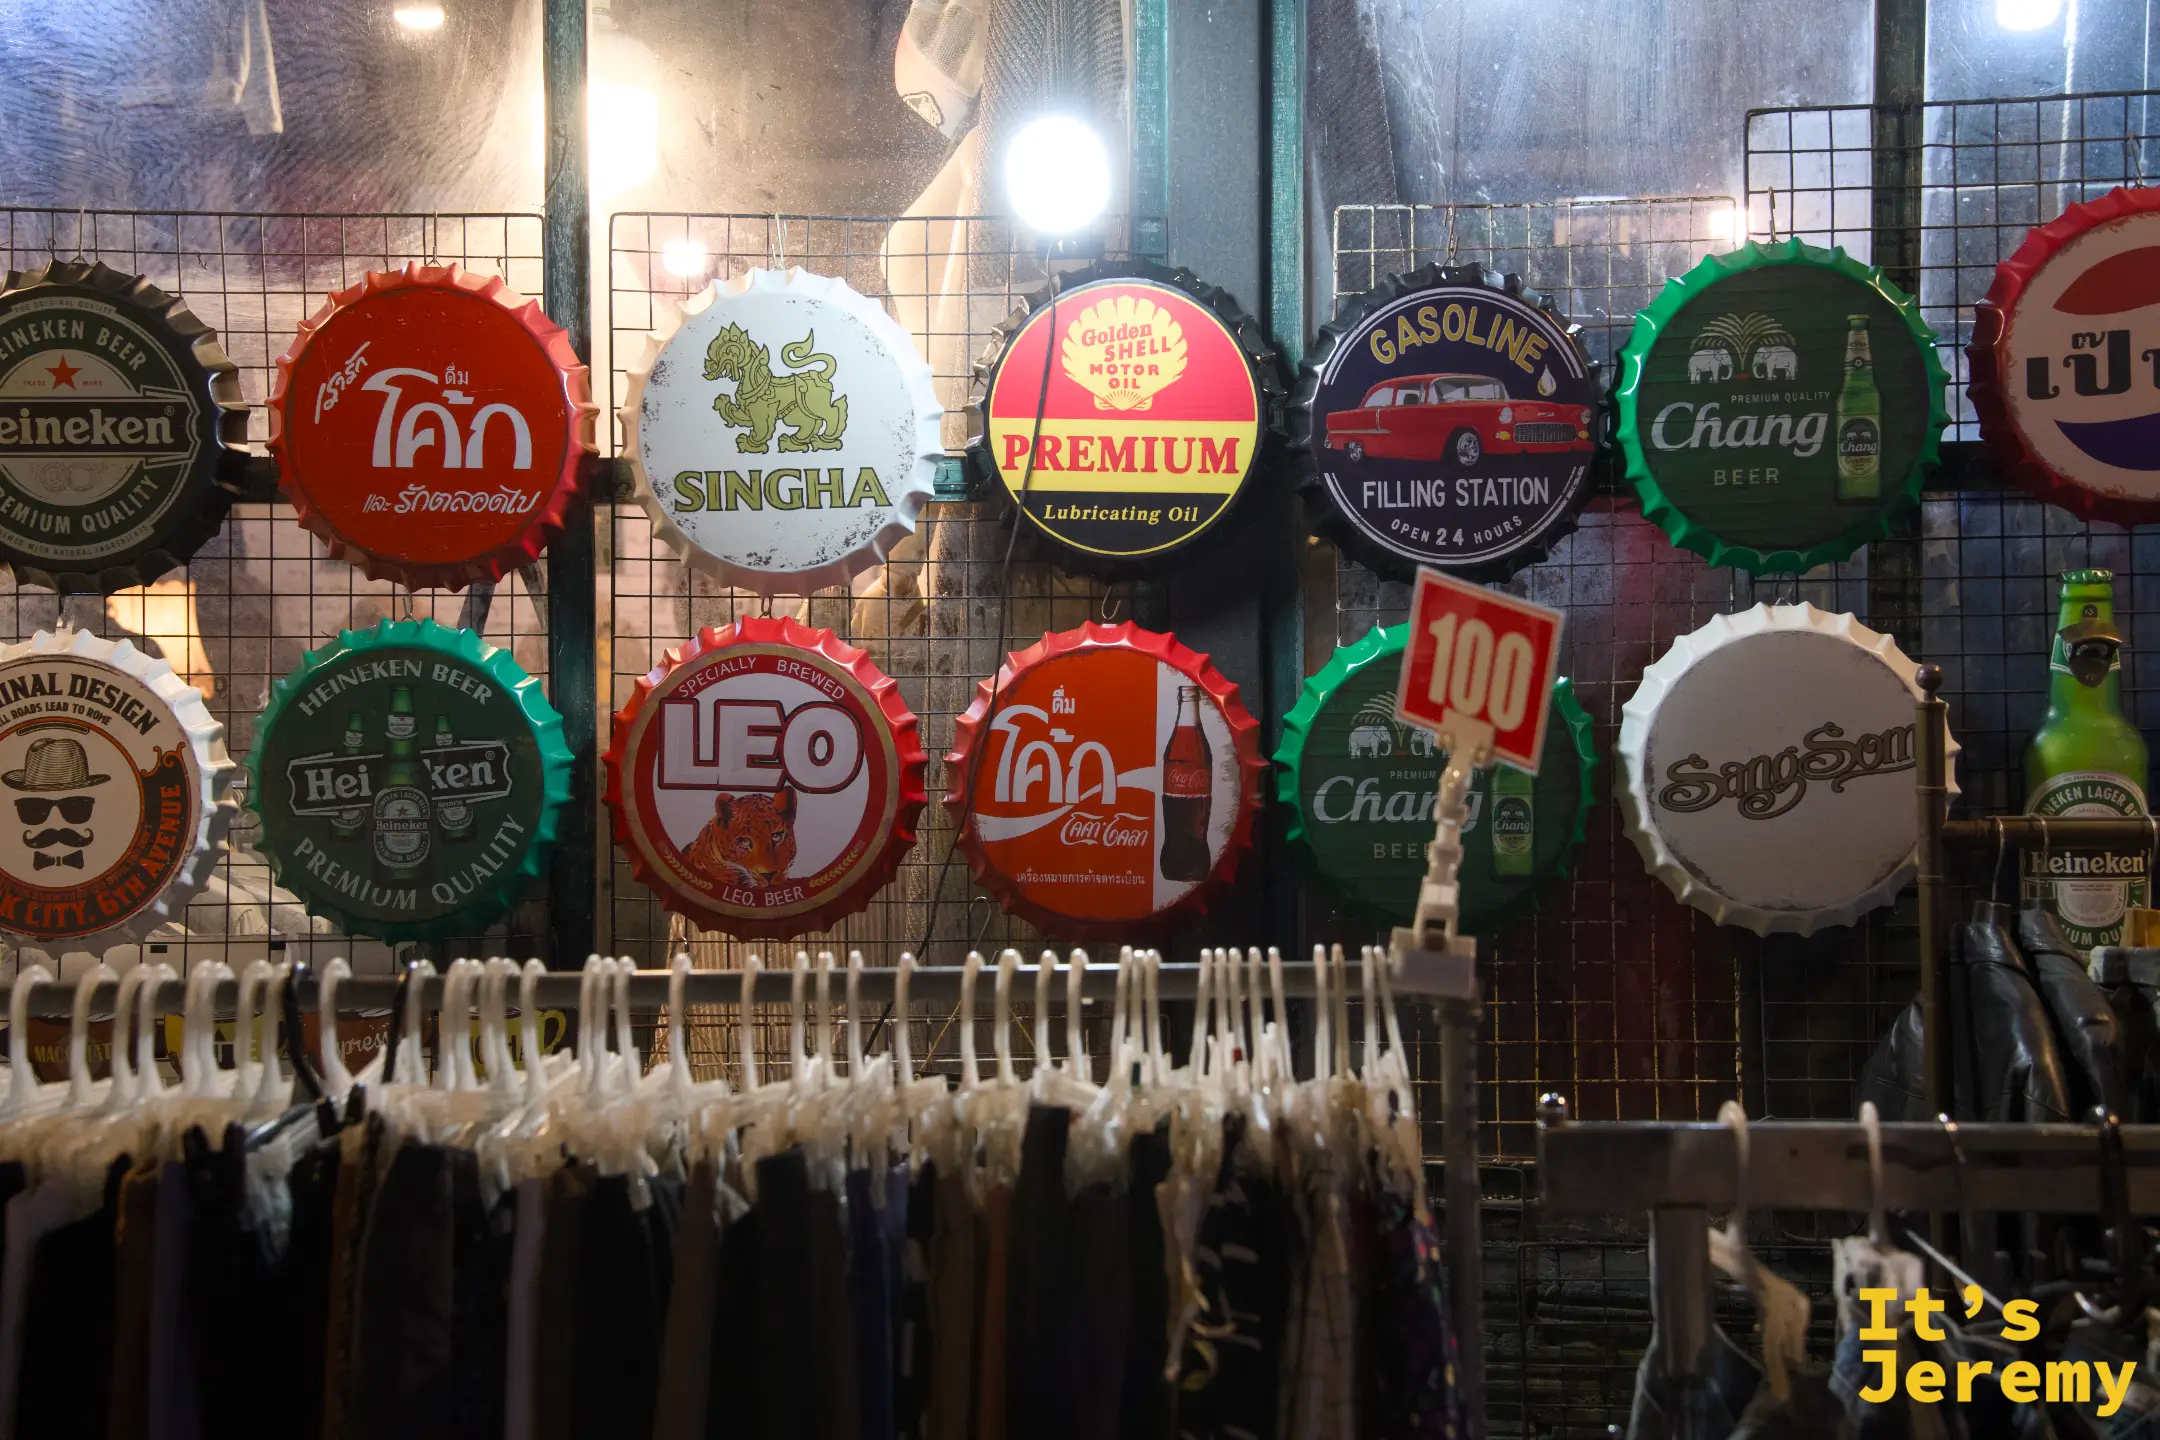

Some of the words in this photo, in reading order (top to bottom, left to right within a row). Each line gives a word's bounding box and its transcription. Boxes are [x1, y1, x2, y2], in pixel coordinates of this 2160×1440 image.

[0, 319, 85, 361] EINEKEN
[96, 327, 147, 372] BEER
[1081, 322, 1153, 347] Golden
[1104, 335, 1172, 363] SHELL
[1369, 303, 1550, 374] GASOLINE
[444, 361, 469, 386] ดื่ม
[1089, 363, 1160, 376] MOTOR
[1108, 377, 1141, 390] OIL
[1730, 392, 1780, 405] PREMIUM
[1784, 391, 1831, 402] QUALITY
[0, 407, 175, 445] eineken
[361, 367, 533, 470] โค้ก
[1651, 401, 1829, 458] Chang
[1001, 433, 1241, 475] PREMIUM
[1839, 441, 1878, 454] Chang
[673, 466, 894, 512] SINGHA
[1713, 467, 1780, 486] BEER
[0, 486, 71, 535] EMIUM
[81, 474, 160, 534] QUALITY
[362, 493, 390, 514] และ
[394, 483, 541, 515] รักตลอดไป
[1362, 478, 1446, 509] FILLING
[1455, 476, 1550, 508] STATION
[1043, 504, 1162, 526] Lubricating
[1168, 505, 1199, 523] Oil
[1390, 518, 1431, 544] OPEN
[1435, 527, 1465, 547] 24
[1474, 515, 1523, 545] HOURS
[678, 656, 758, 698] SPECIALLY
[776, 659, 845, 700] BREWED
[1427, 611, 1534, 732] 100
[298, 659, 423, 717] HEINEKEN
[431, 663, 494, 706] BEER
[1051, 684, 1076, 715] ดื่ม
[10, 702, 43, 720] ROADS
[45, 701, 69, 712] LEAD
[72, 703, 85, 715] TO
[86, 707, 113, 726] ROME
[67, 672, 161, 736] DESIGN
[657, 697, 865, 794] LEO
[1389, 770, 1437, 780] PREMIUM
[2041, 785, 2083, 816] NEKEN
[2087, 785, 2127, 807] LAGER
[375, 819, 428, 831] Heineken
[1494, 818, 1531, 833] Chang
[97, 873, 148, 917] 6TH
[138, 783, 182, 880] AVENUE
[292, 836, 417, 910] PREMIUM
[431, 813, 525, 905] QUALITY
[1373, 842, 1430, 859] BEE
[2030, 851, 2144, 874] Heineken
[764, 885, 805, 908] BEER
